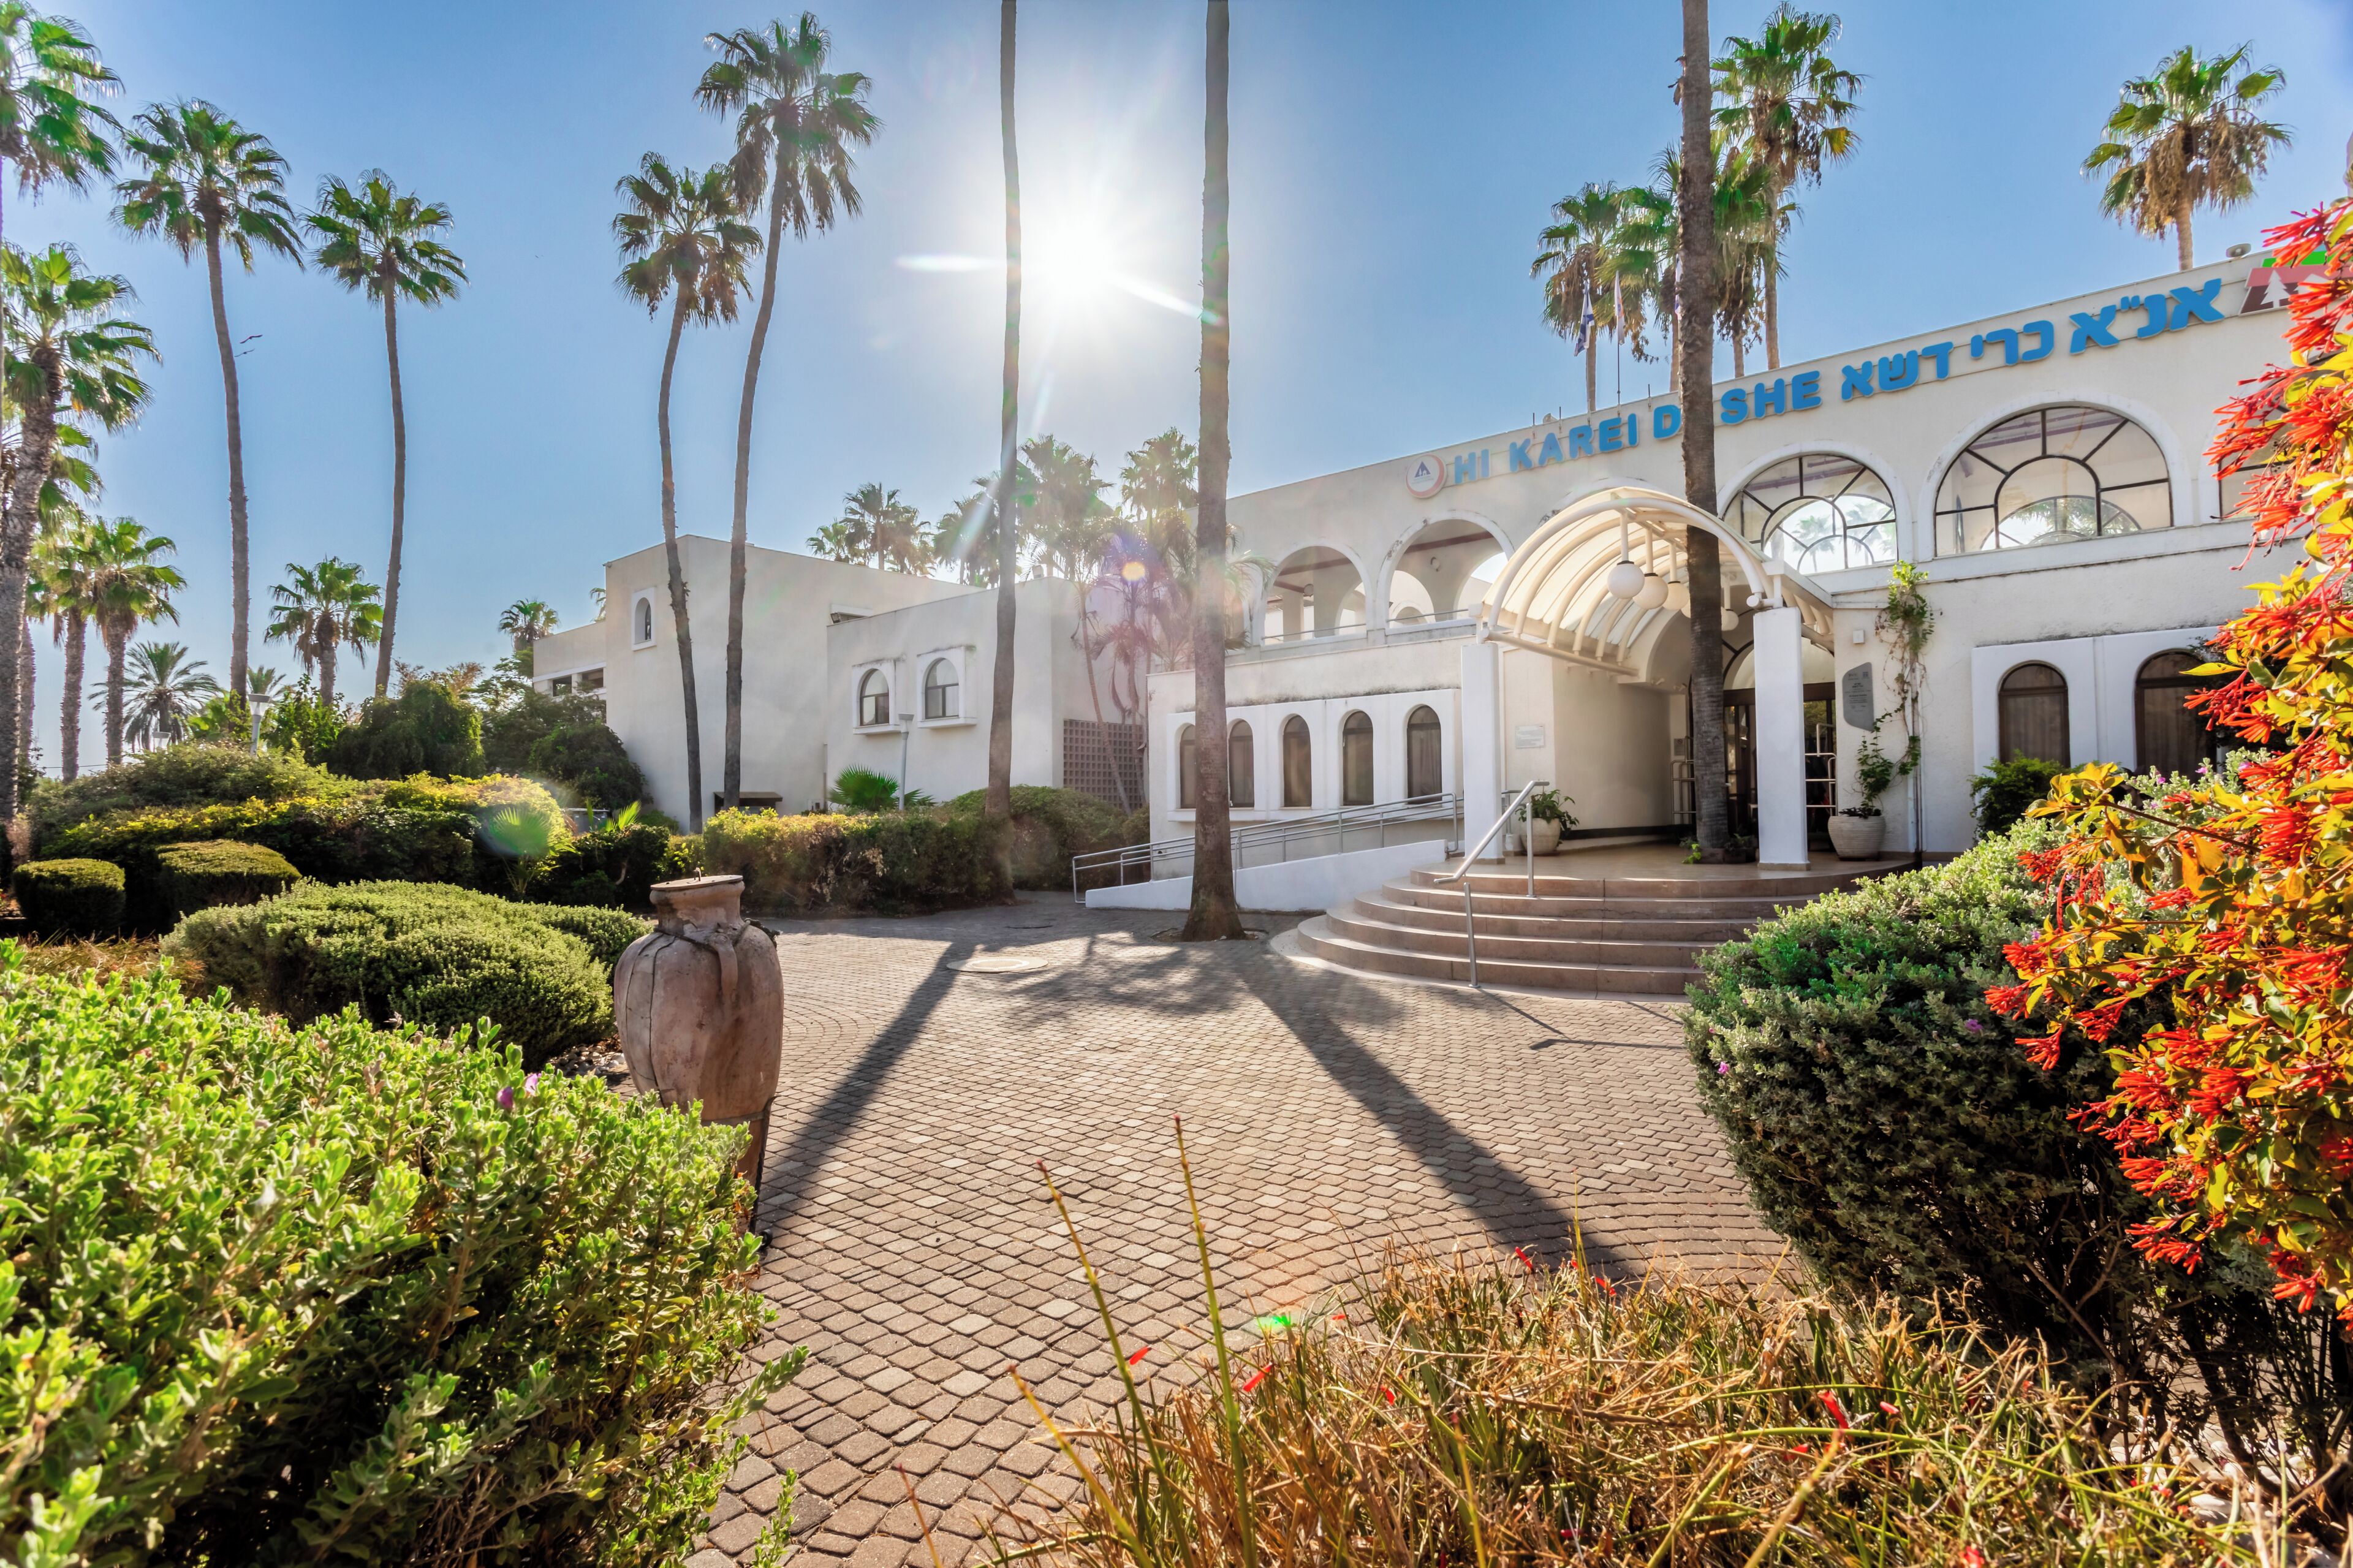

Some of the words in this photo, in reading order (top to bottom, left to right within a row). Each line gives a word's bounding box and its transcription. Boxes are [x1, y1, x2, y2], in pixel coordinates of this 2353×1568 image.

[1841, 341, 1954, 401] דשא
[1969, 319, 2055, 365] כרי
[1454, 449, 1490, 485] HI
[1509, 412, 1639, 472] KAREI
[1653, 369, 1822, 440] DSHE
